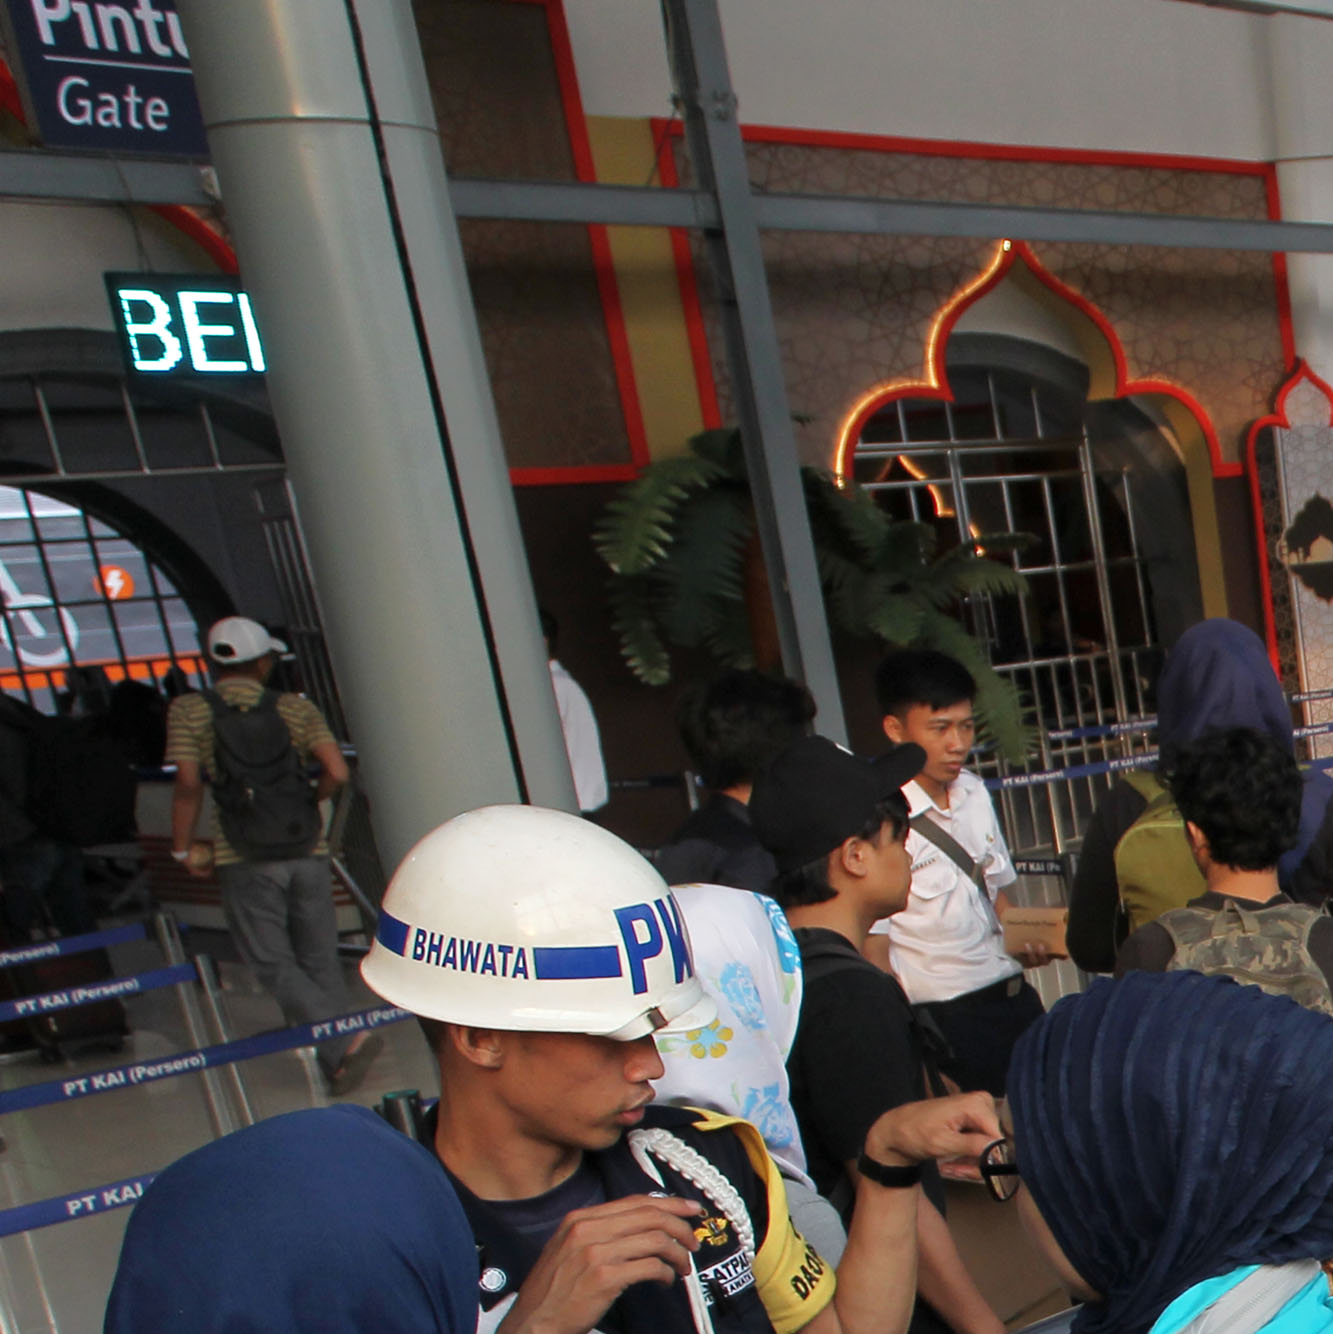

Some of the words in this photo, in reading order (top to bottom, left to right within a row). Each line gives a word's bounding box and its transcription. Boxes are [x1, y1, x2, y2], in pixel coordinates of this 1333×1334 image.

[57, 76, 170, 132] Gate
[412, 927, 530, 980] BHAWATA
[15, 1000, 37, 1014] PT
[40, 993, 68, 1009] KAI
[72, 978, 140, 1004] (Persero)
[312, 1023, 333, 1039] PT
[336, 1015, 364, 1033] KAI
[62, 1078, 89, 1097] PT
[92, 1070, 126, 1090] KAI
[129, 1053, 207, 1083] (Persero)
[66, 1194, 97, 1216] PT
[101, 1182, 145, 1206] KAI
